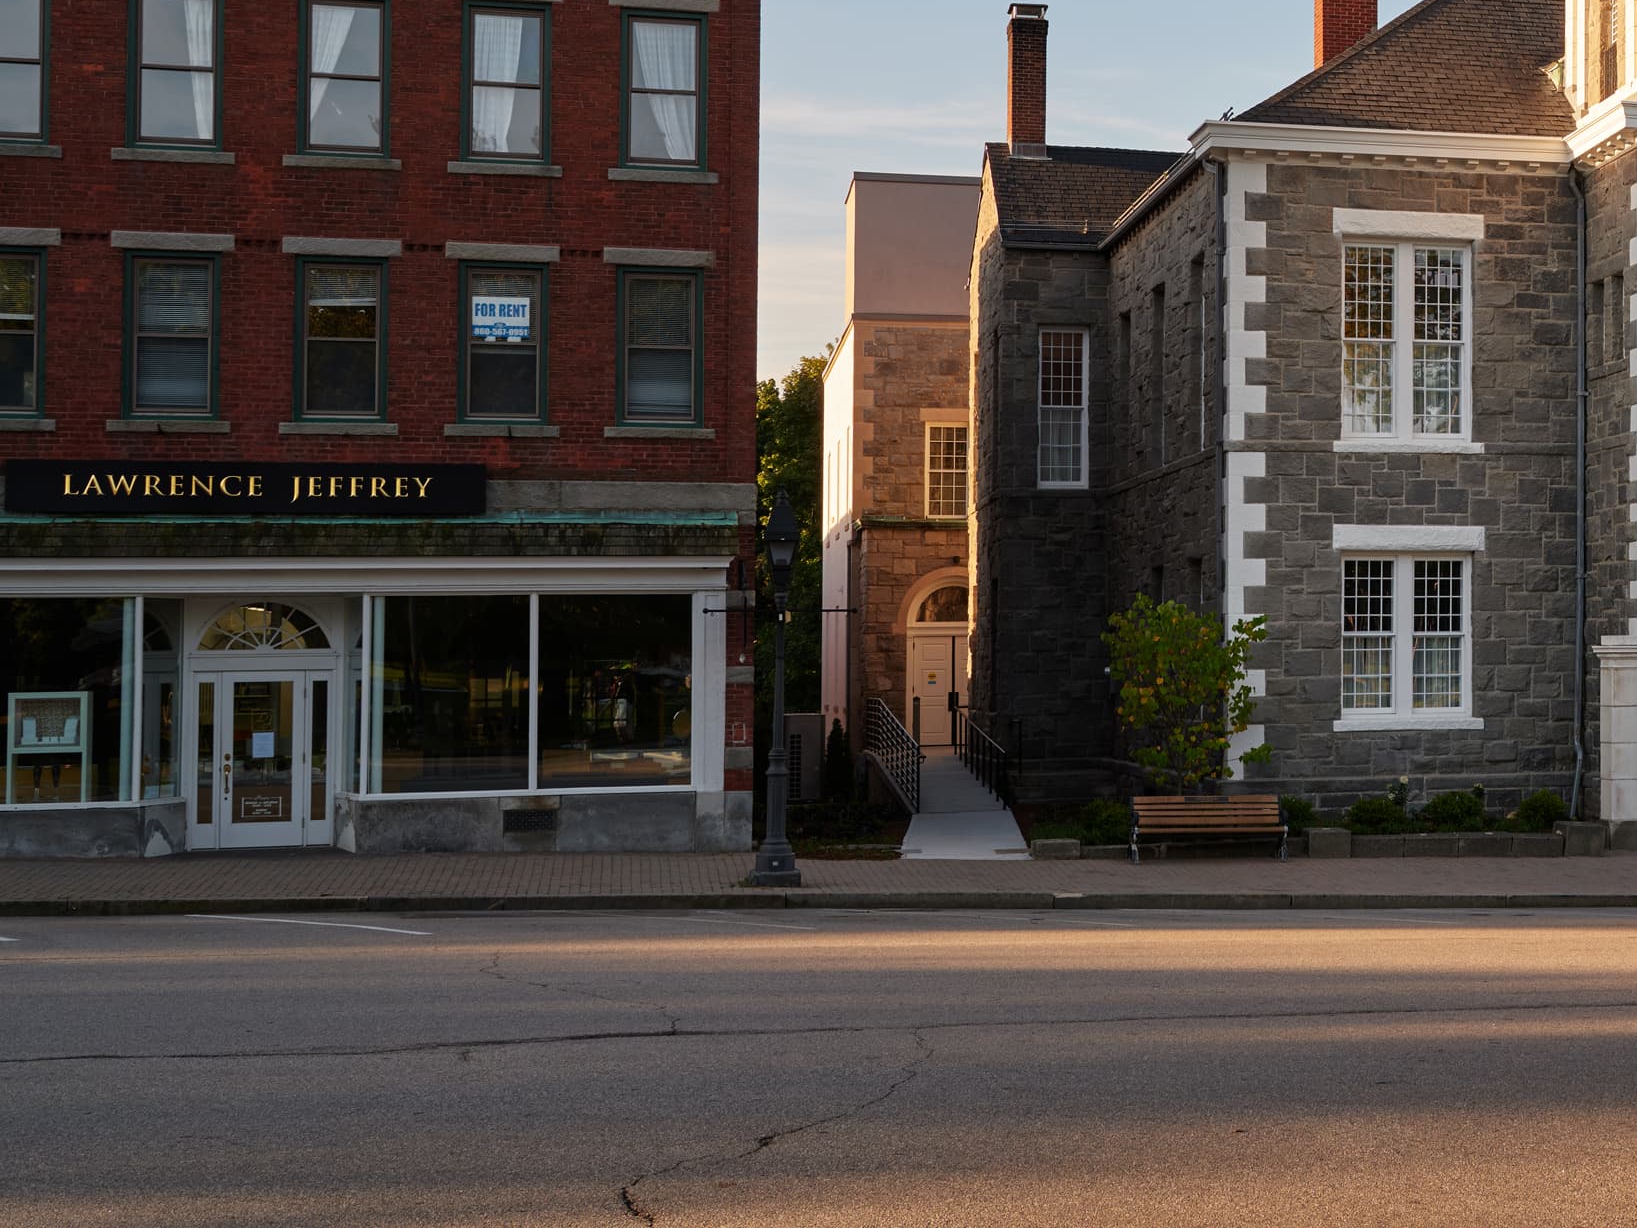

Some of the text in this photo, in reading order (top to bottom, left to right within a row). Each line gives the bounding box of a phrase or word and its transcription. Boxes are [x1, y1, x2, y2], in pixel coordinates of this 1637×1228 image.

[475, 303, 527, 318] FOR RENT
[63, 474, 434, 504] LAWRENCE JEFFREY
